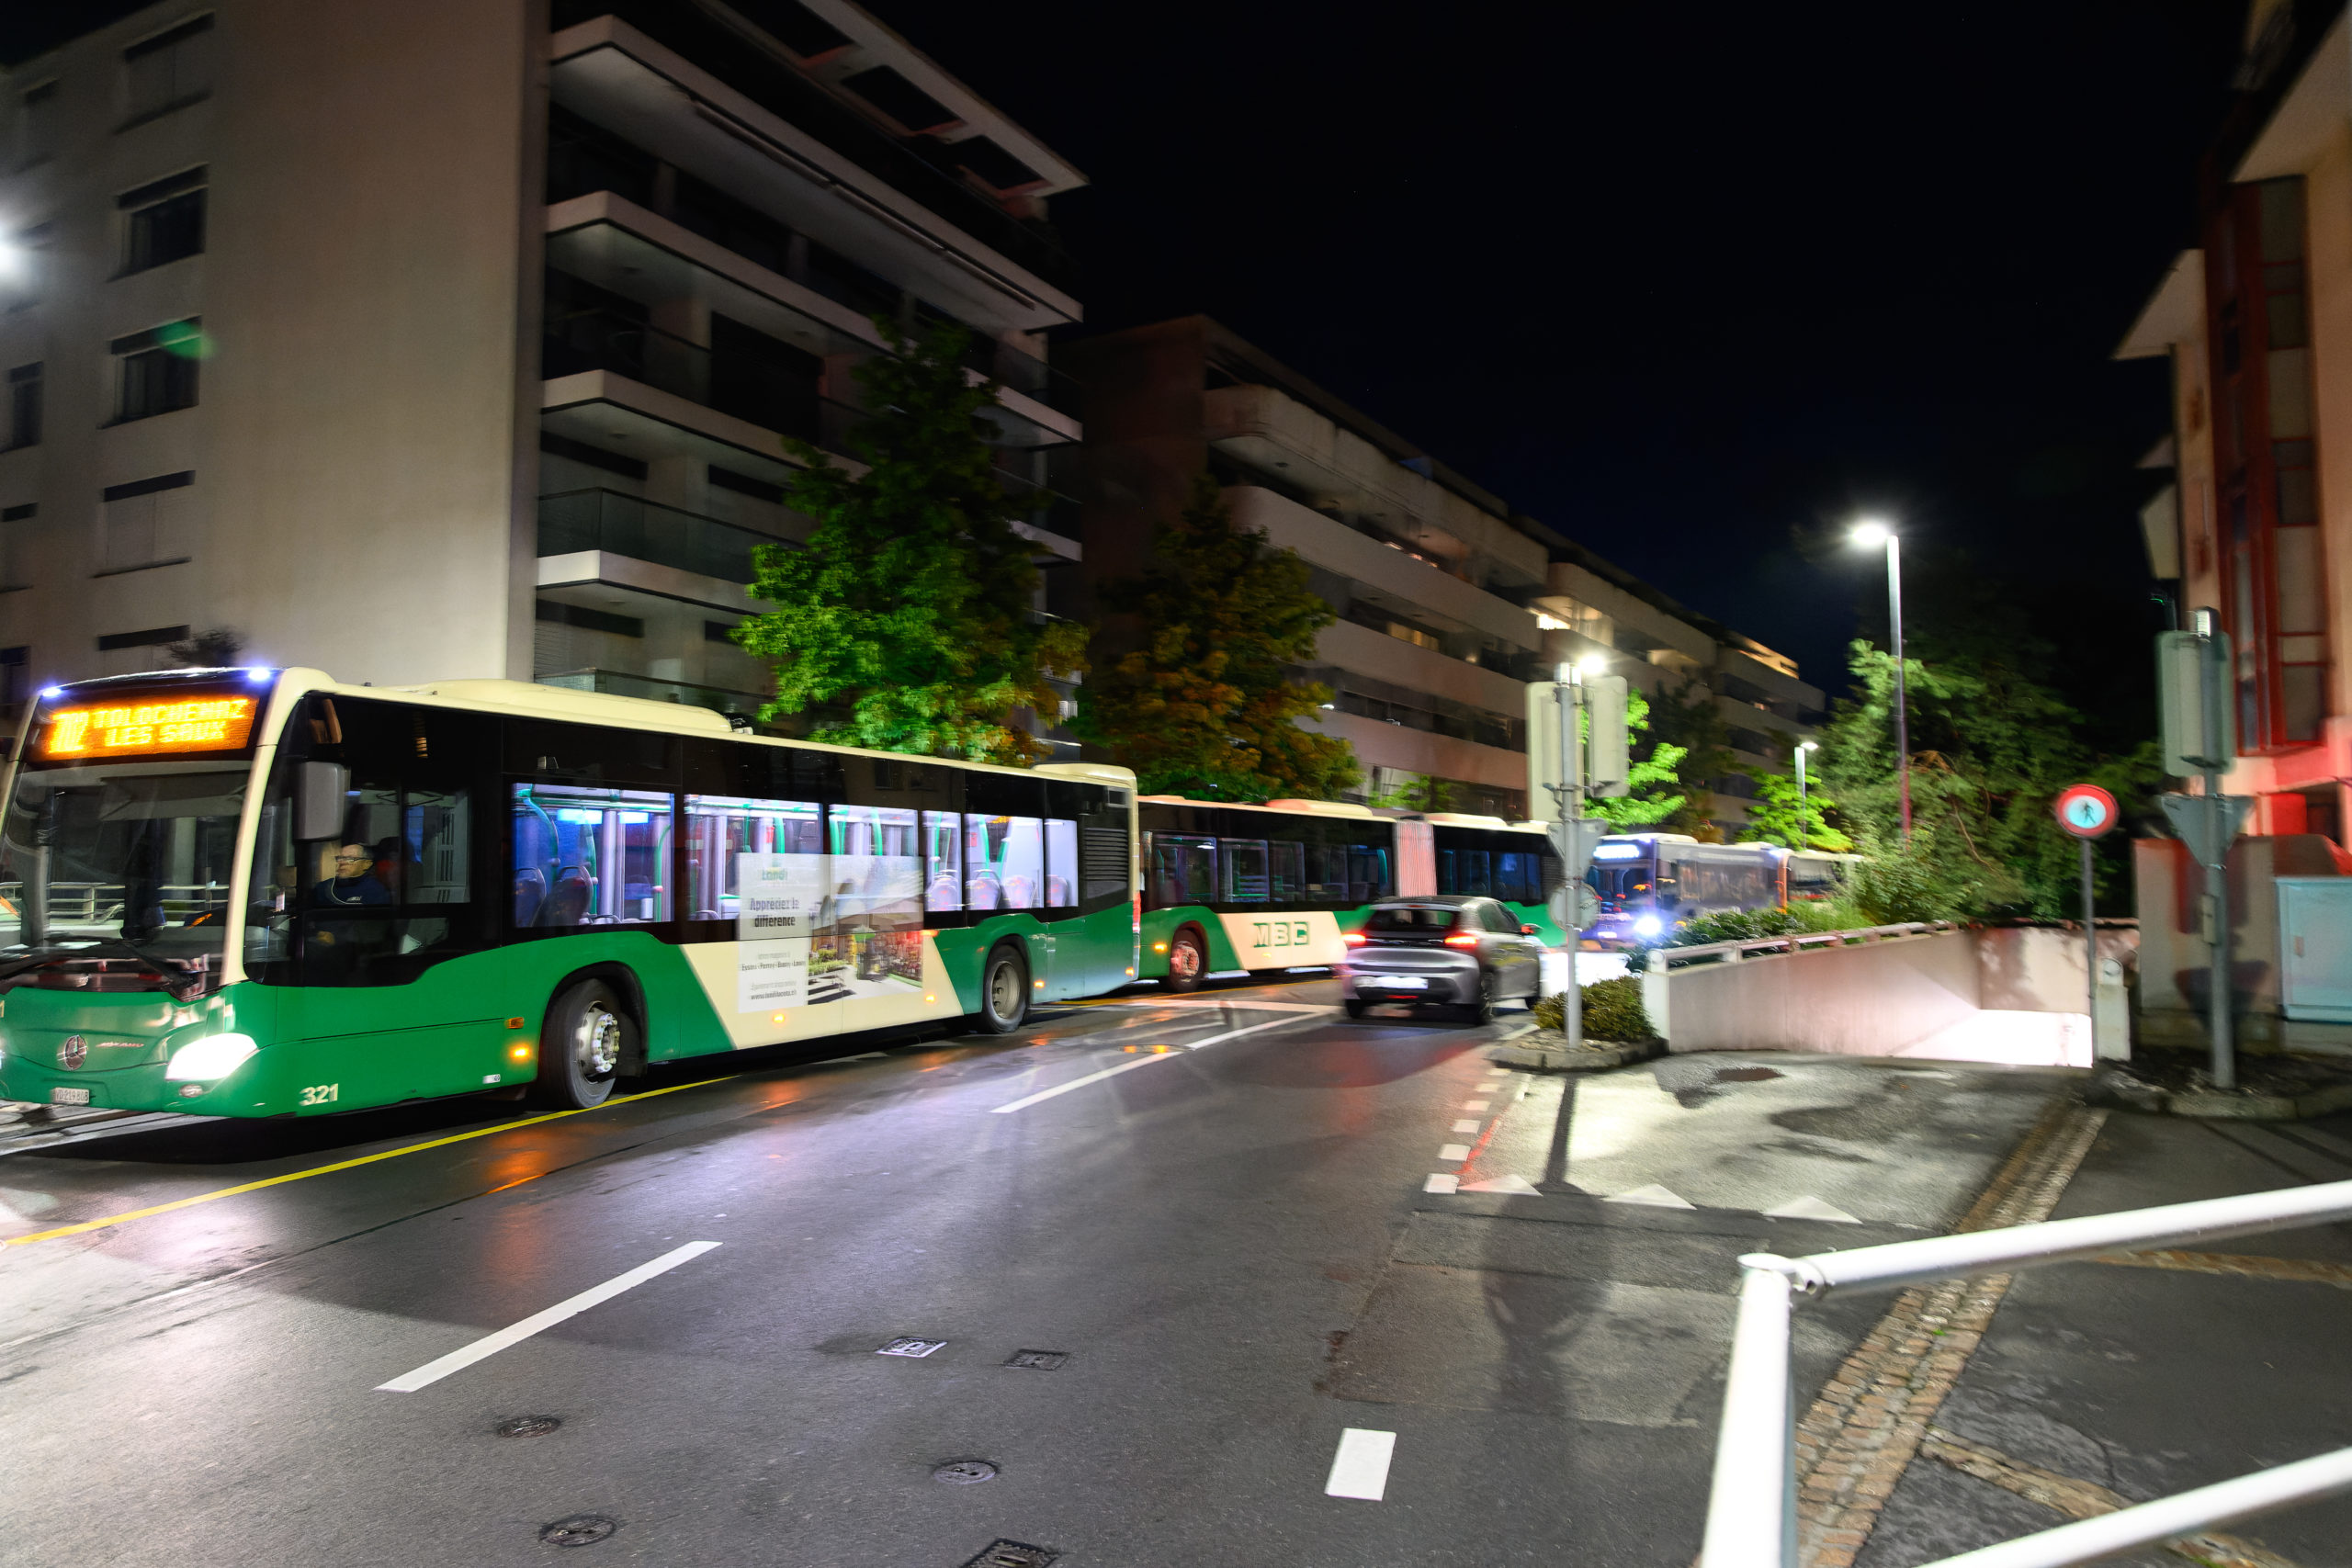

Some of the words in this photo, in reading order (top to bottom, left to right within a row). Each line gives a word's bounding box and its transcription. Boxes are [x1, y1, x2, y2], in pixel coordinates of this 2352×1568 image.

[93, 699, 247, 728] TOLOCHENAZ
[104, 726, 152, 746] LES
[754, 914, 796, 928] différence
[1252, 921, 1310, 948] MBC
[299, 1083, 339, 1106] 321
